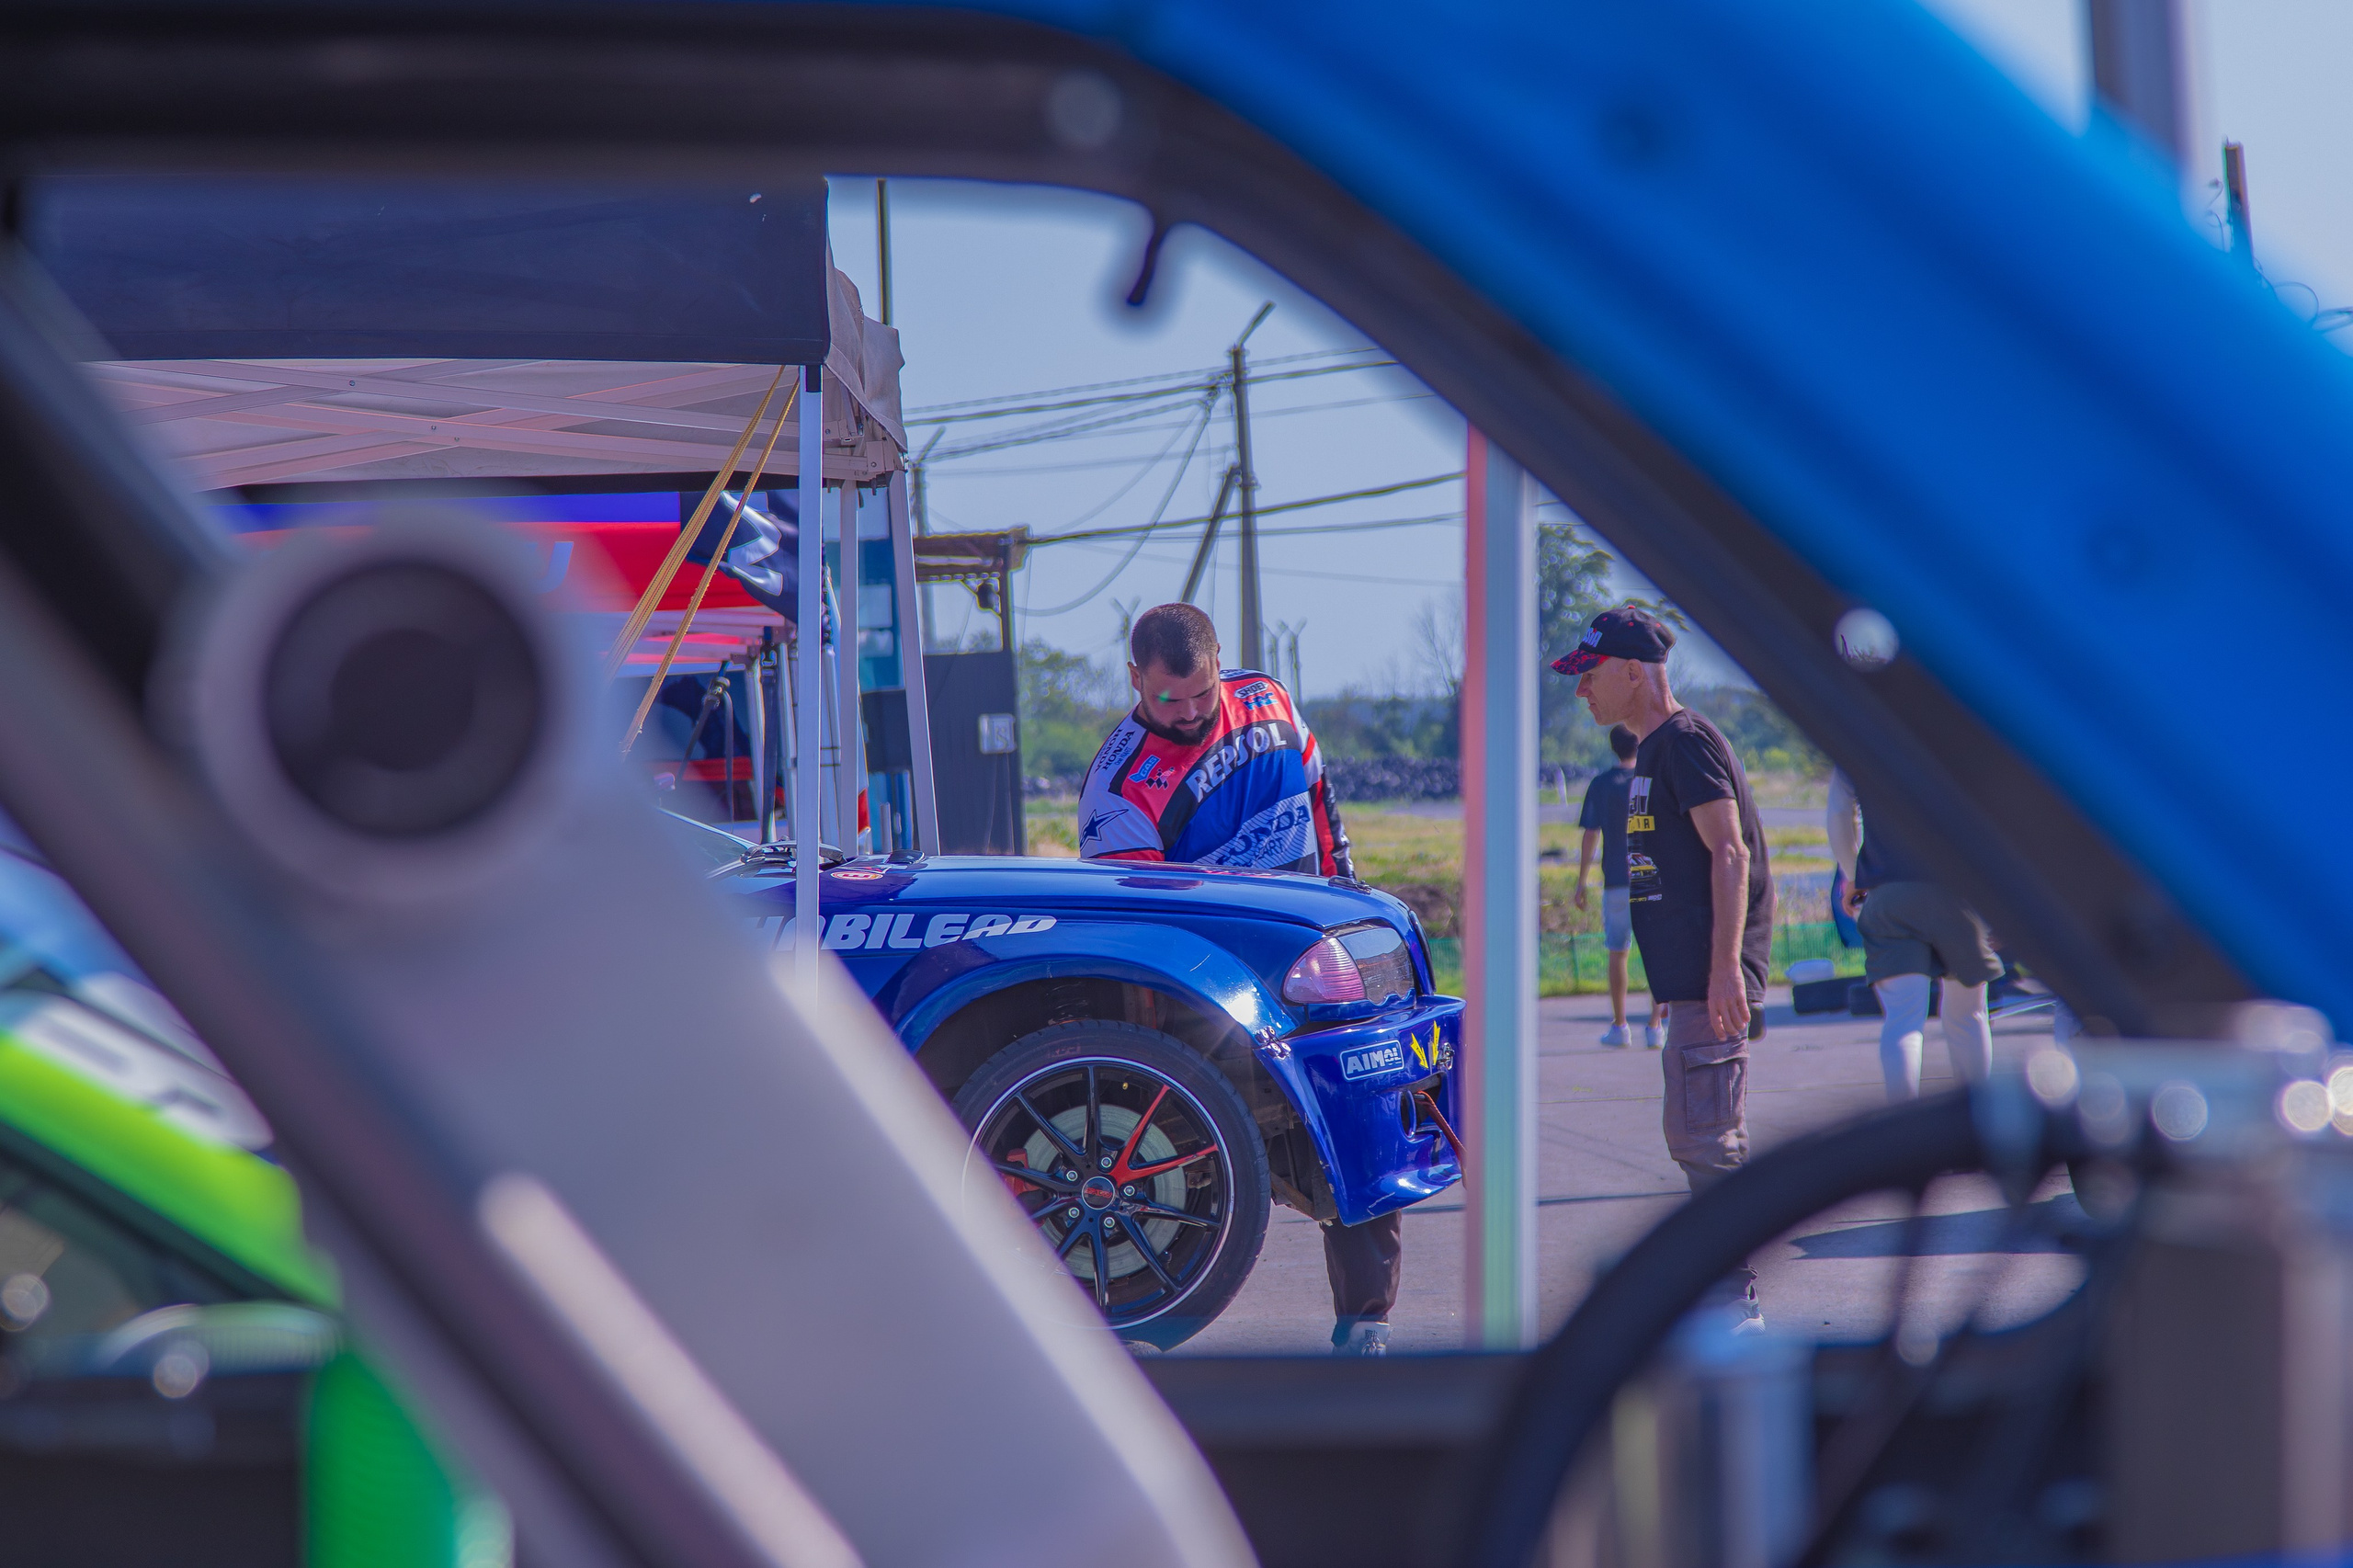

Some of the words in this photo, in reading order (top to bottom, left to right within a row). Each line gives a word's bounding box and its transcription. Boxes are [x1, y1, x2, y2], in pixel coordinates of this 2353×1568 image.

[1103, 731, 1136, 770] HONDA
[1141, 756, 1157, 778] GAS
[1186, 722, 1287, 802] REPSOL
[1215, 805, 1311, 866] ONDA
[1347, 1048, 1402, 1074] AIMOL
